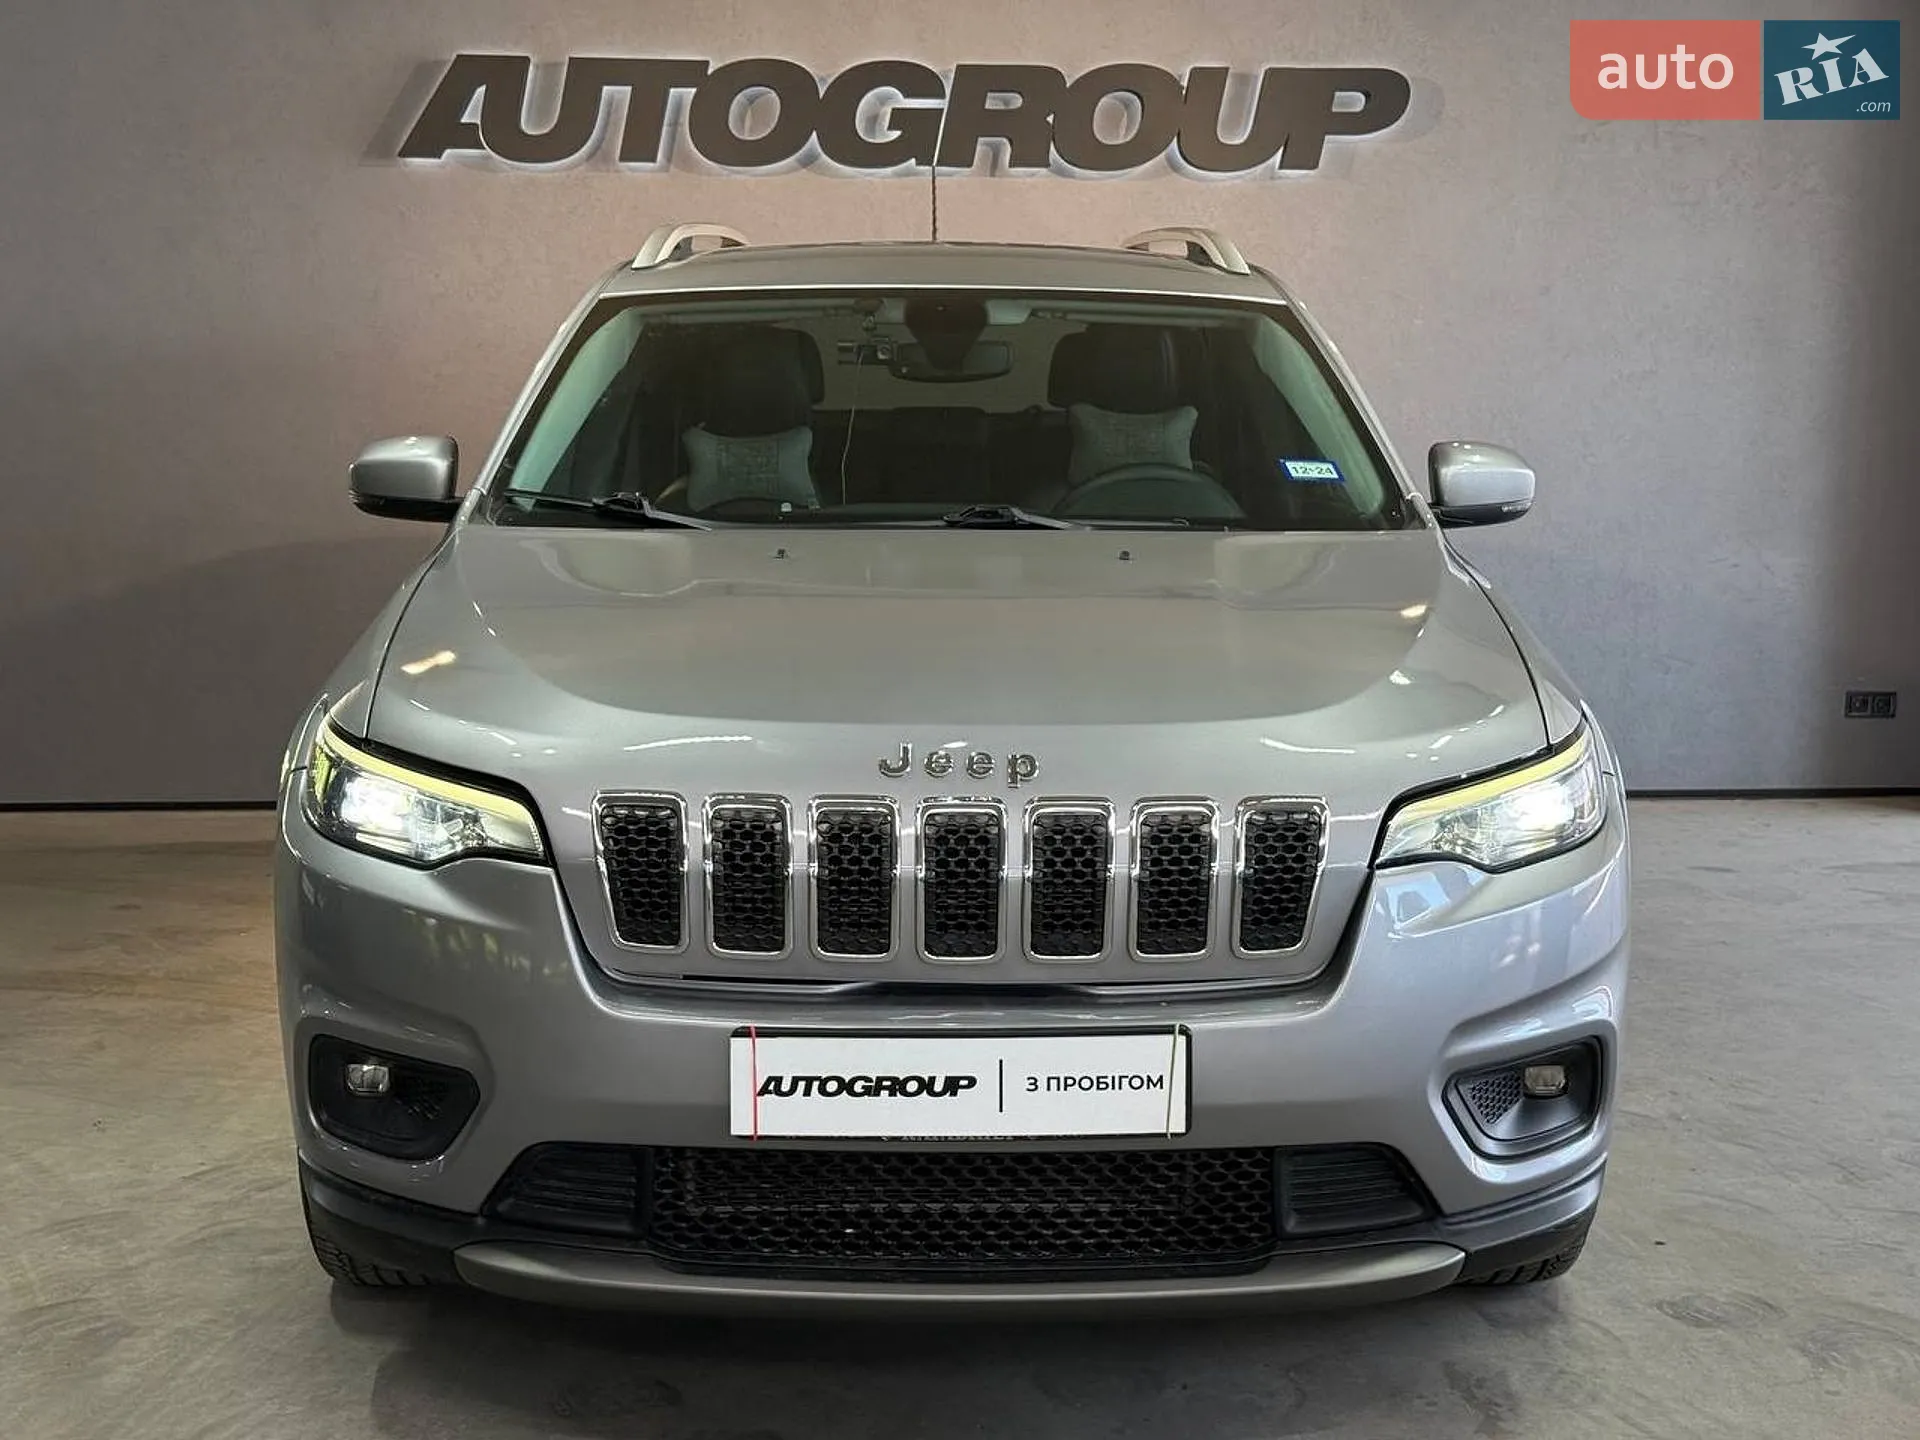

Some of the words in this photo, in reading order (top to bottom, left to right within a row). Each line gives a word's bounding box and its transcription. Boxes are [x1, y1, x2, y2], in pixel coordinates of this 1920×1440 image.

[398, 54, 1411, 171] AUTOGROUP
[878, 741, 1040, 788] Jeep
[757, 1074, 977, 1098] AUTOGROUP
[1026, 1076, 1039, 1092] З
[1046, 1074, 1165, 1093] ПРОБІГОМ
